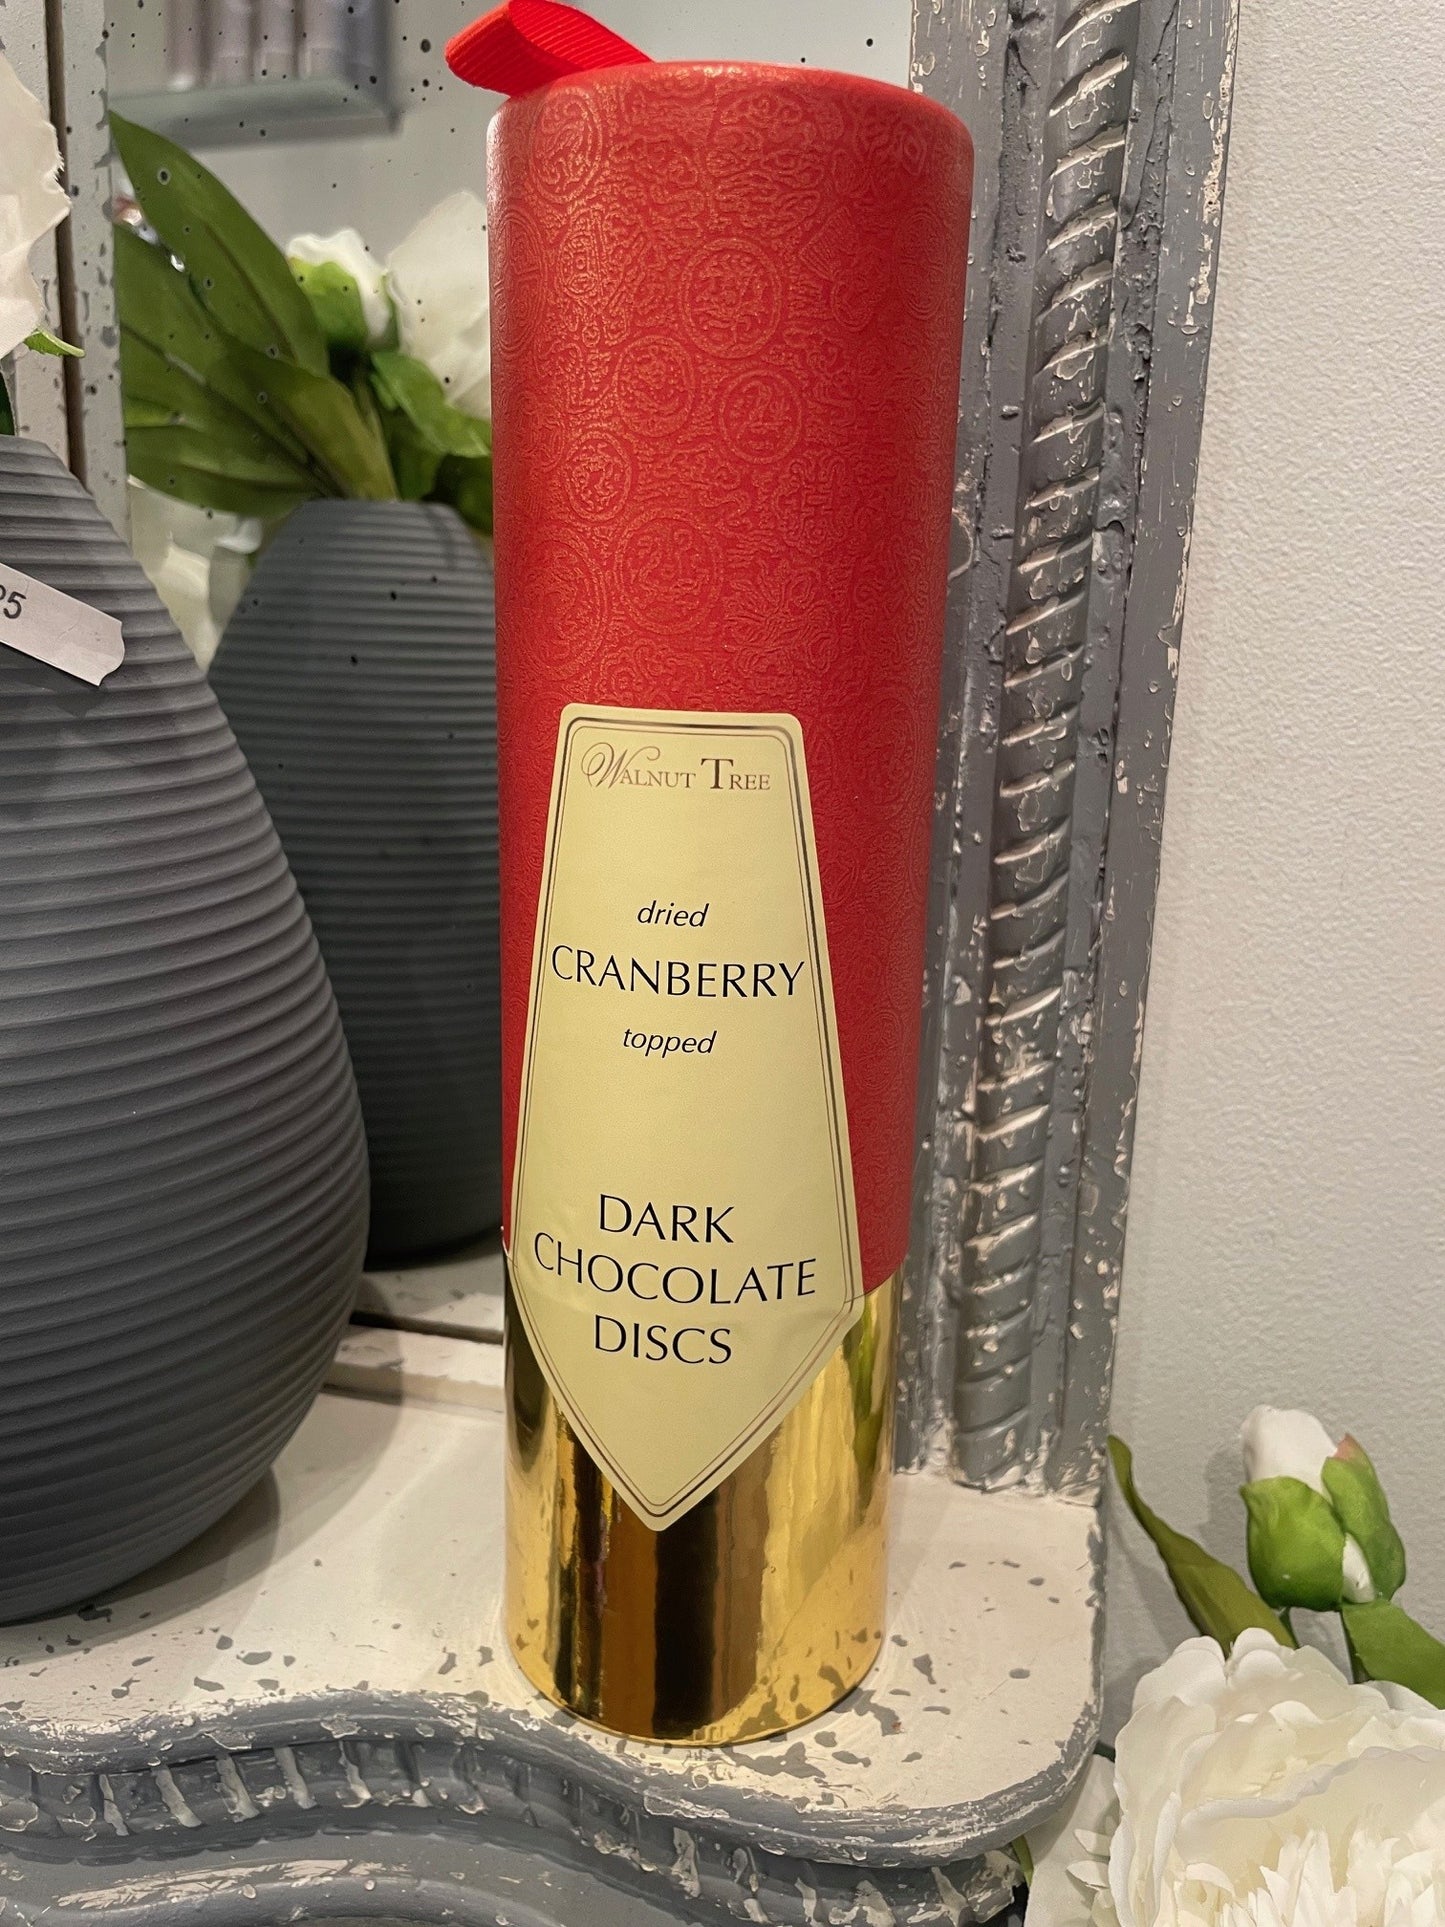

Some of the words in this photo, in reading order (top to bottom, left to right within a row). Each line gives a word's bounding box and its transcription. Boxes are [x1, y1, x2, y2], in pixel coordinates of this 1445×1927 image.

[700, 757, 771, 791] TREE
[636, 899, 710, 928] dried
[551, 944, 805, 998] CRANBERRY
[622, 1028, 718, 1059] topped
[599, 1193, 735, 1244] DARK
[533, 1231, 817, 1305] CHOCOLATE
[594, 1314, 732, 1365] DISCS
